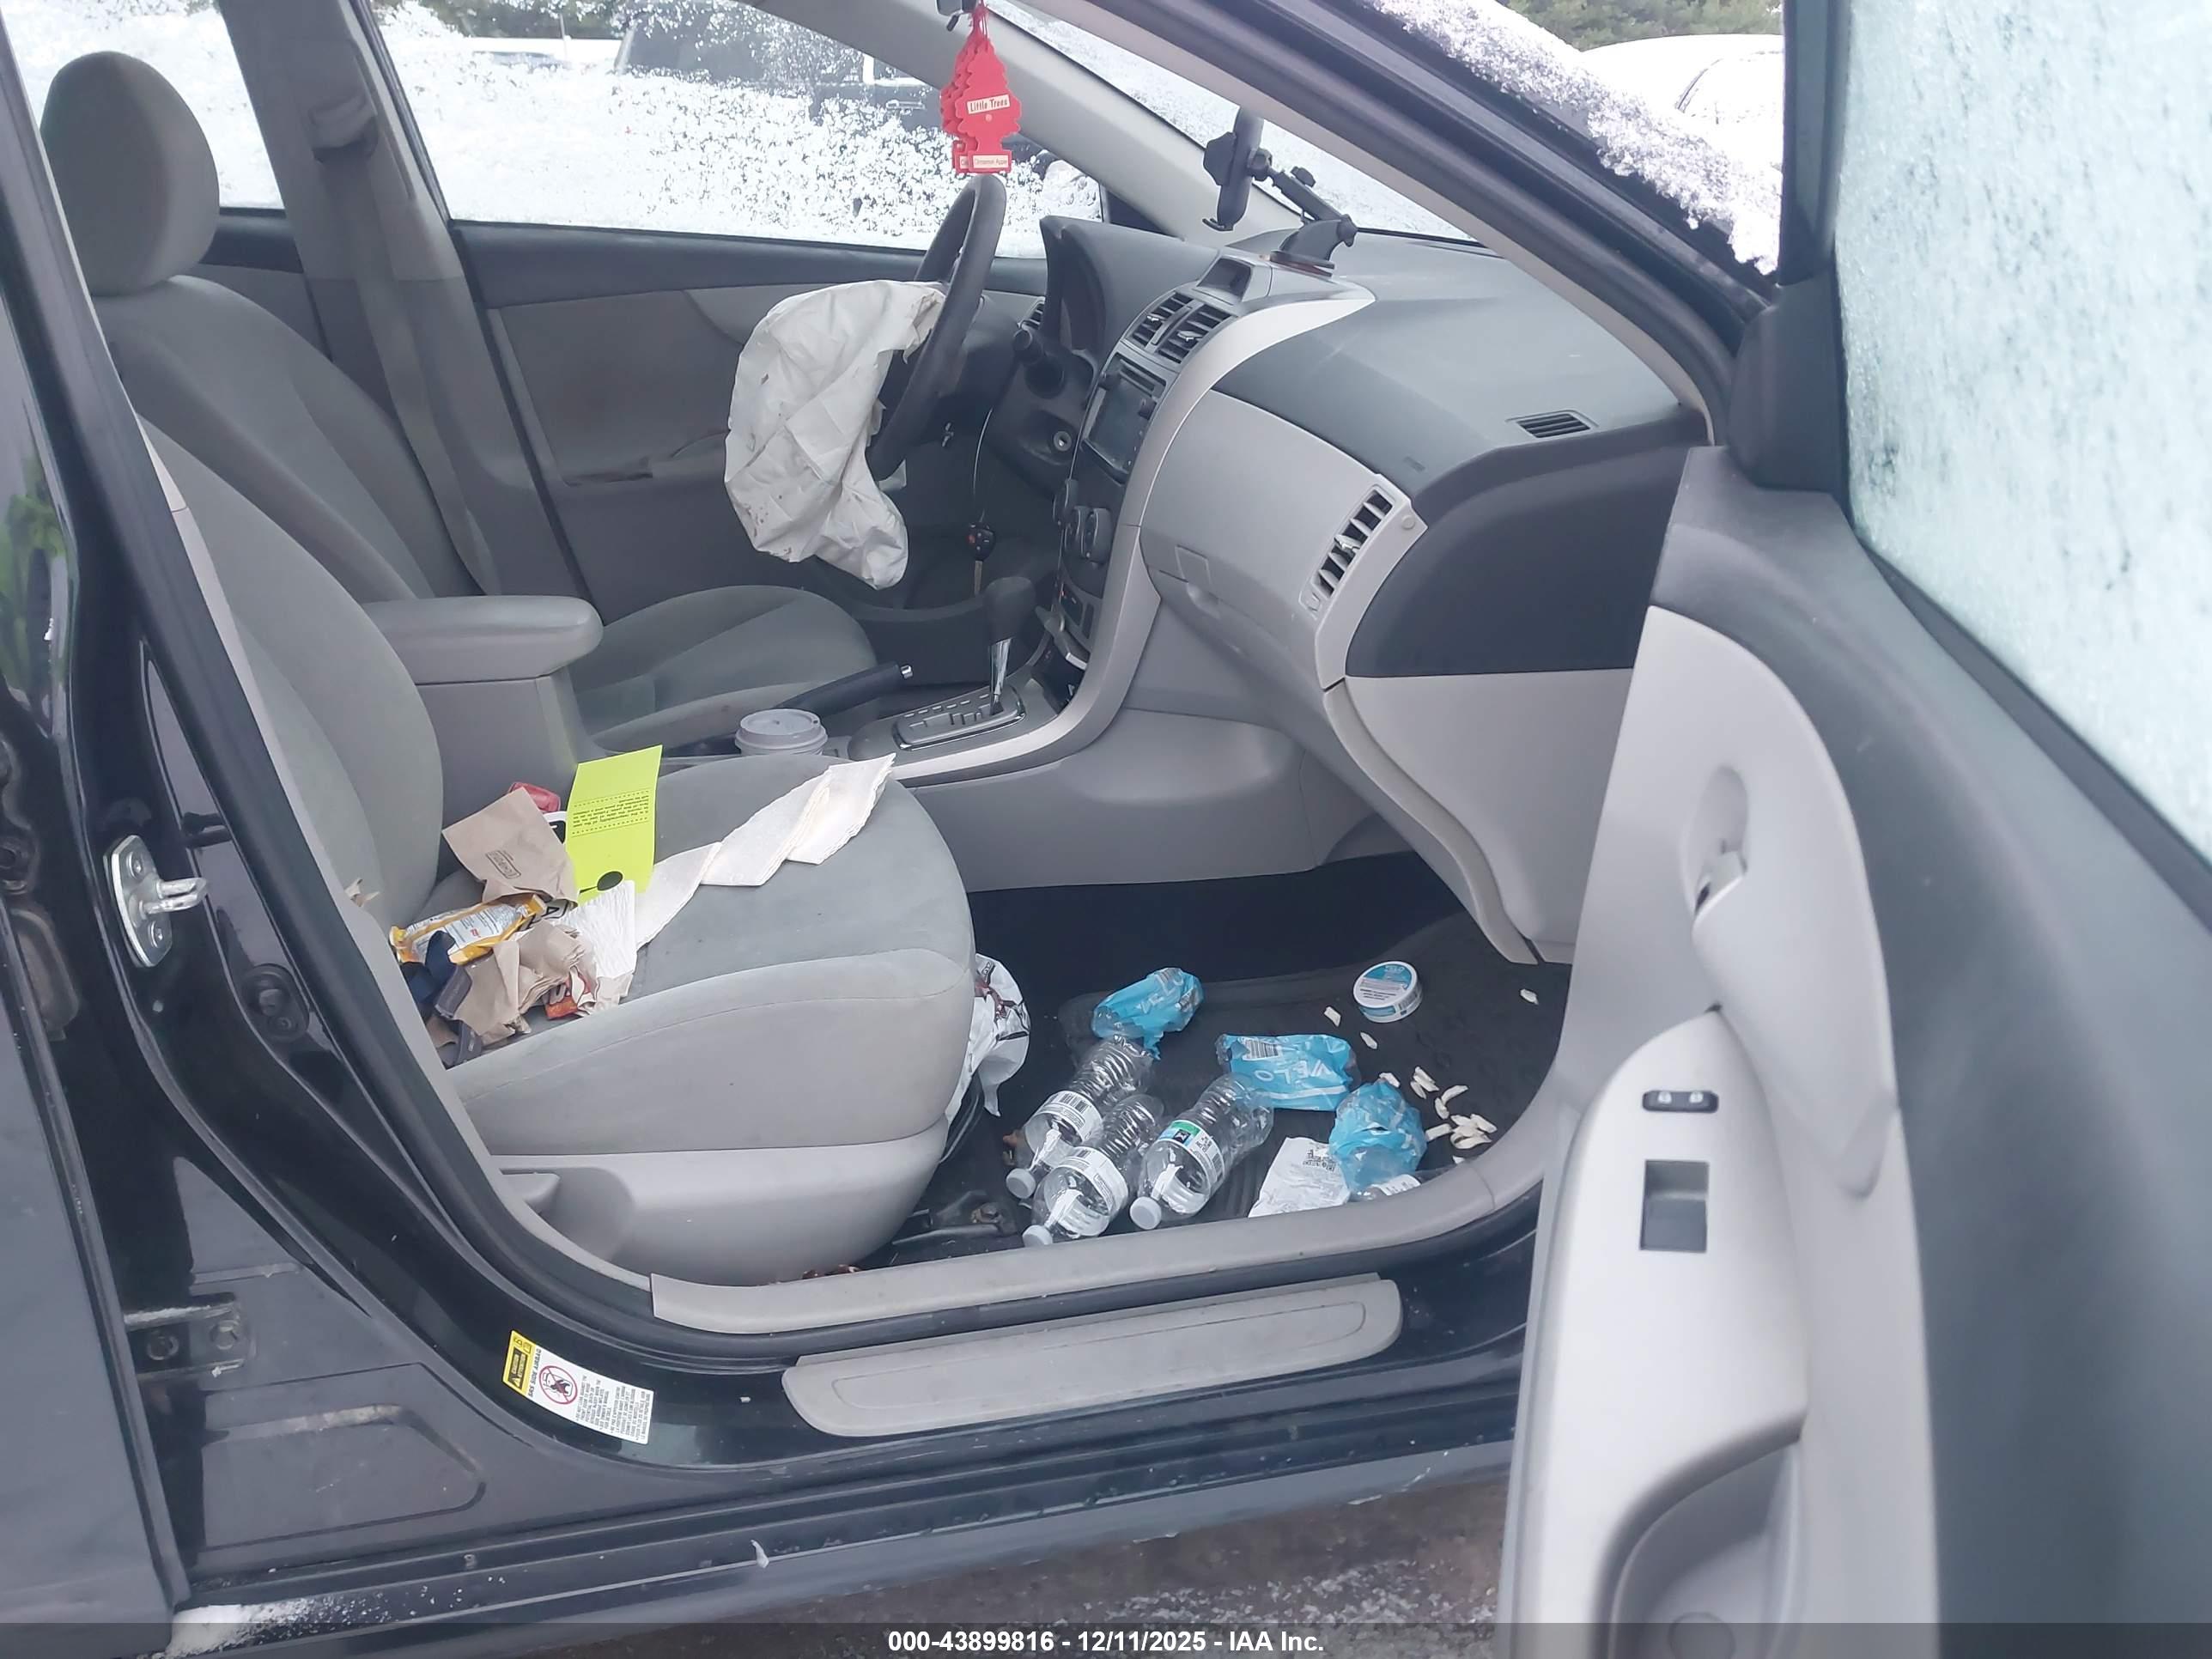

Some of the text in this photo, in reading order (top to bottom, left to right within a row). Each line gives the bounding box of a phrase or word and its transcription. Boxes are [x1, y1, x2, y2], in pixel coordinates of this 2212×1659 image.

[969, 98, 1009, 112] Little Trees
[1254, 1059, 1332, 1085] VELO
